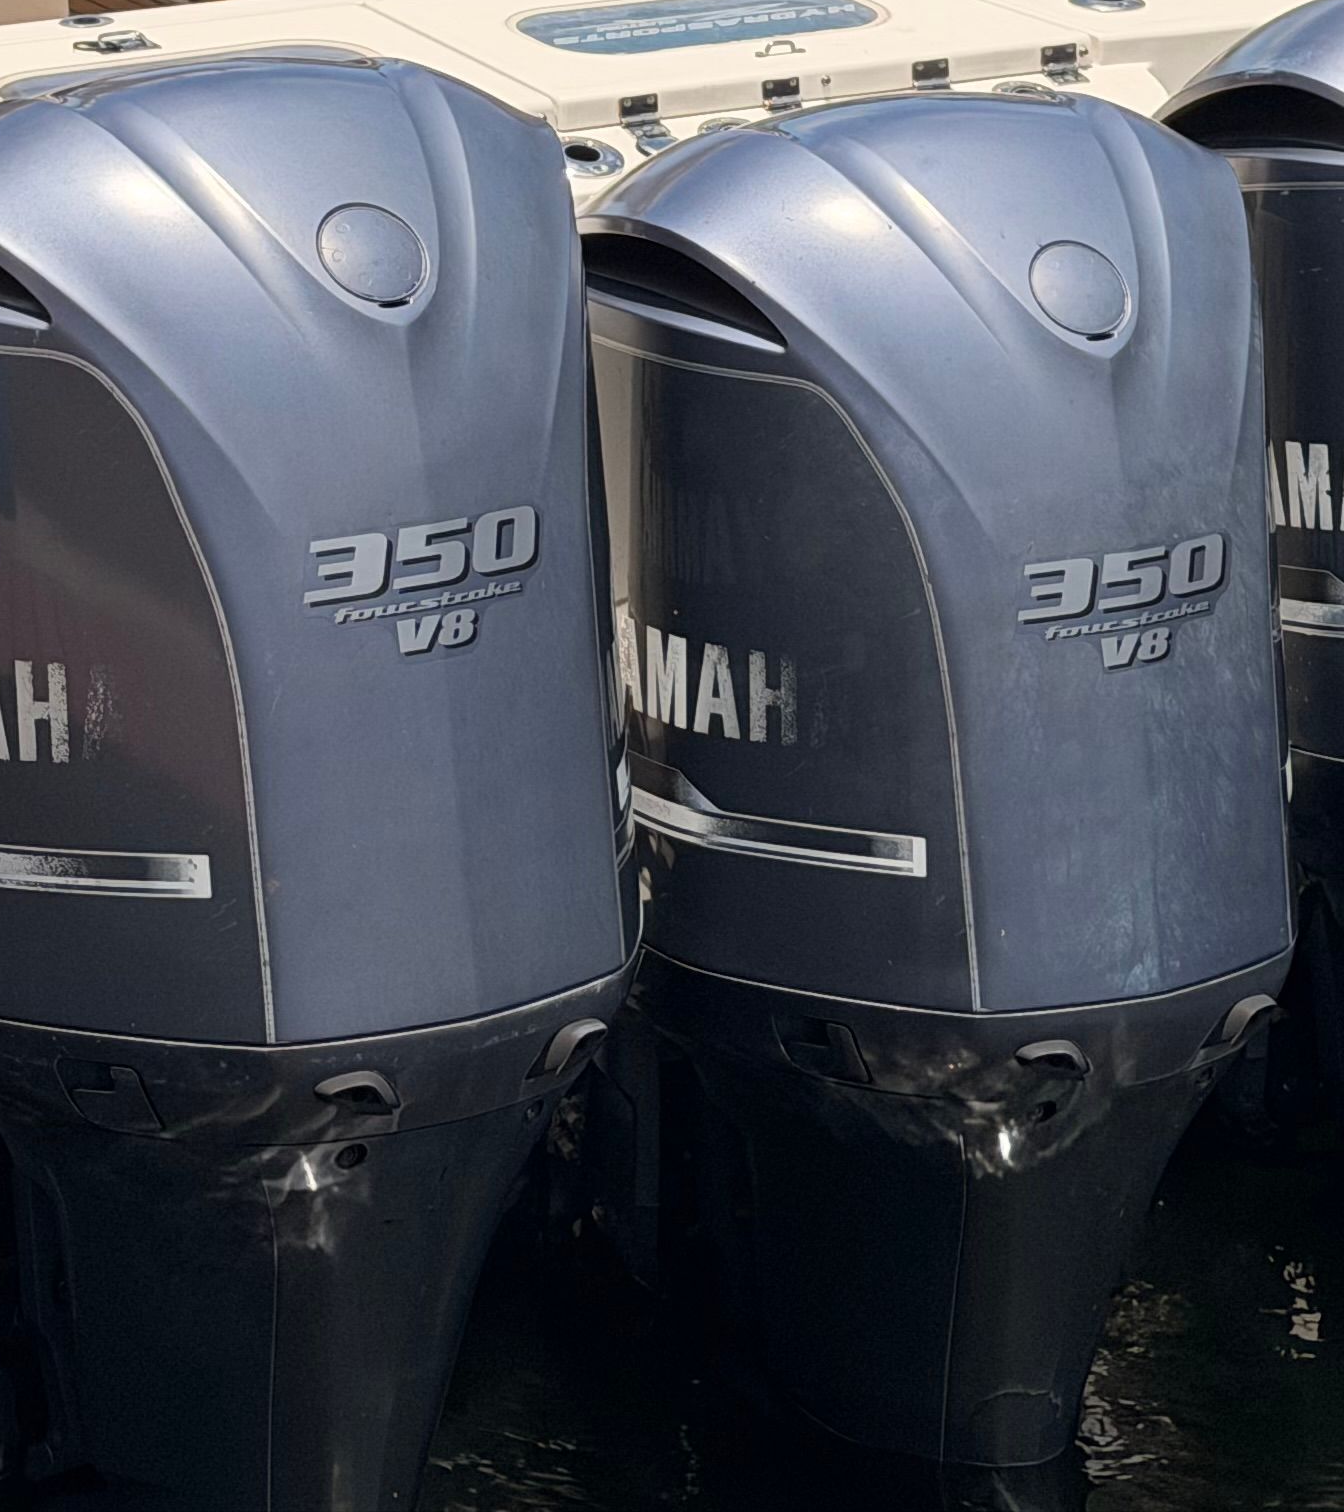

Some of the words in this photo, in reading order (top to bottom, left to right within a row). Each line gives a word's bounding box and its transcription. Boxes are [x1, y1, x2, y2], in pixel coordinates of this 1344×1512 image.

[303, 505, 540, 608] 350
[1018, 533, 1226, 625] 350
[334, 580, 523, 624] fourstroke
[1045, 600, 1211, 641] fourstroke
[396, 608, 478, 656] V8
[1101, 627, 1172, 671] V8
